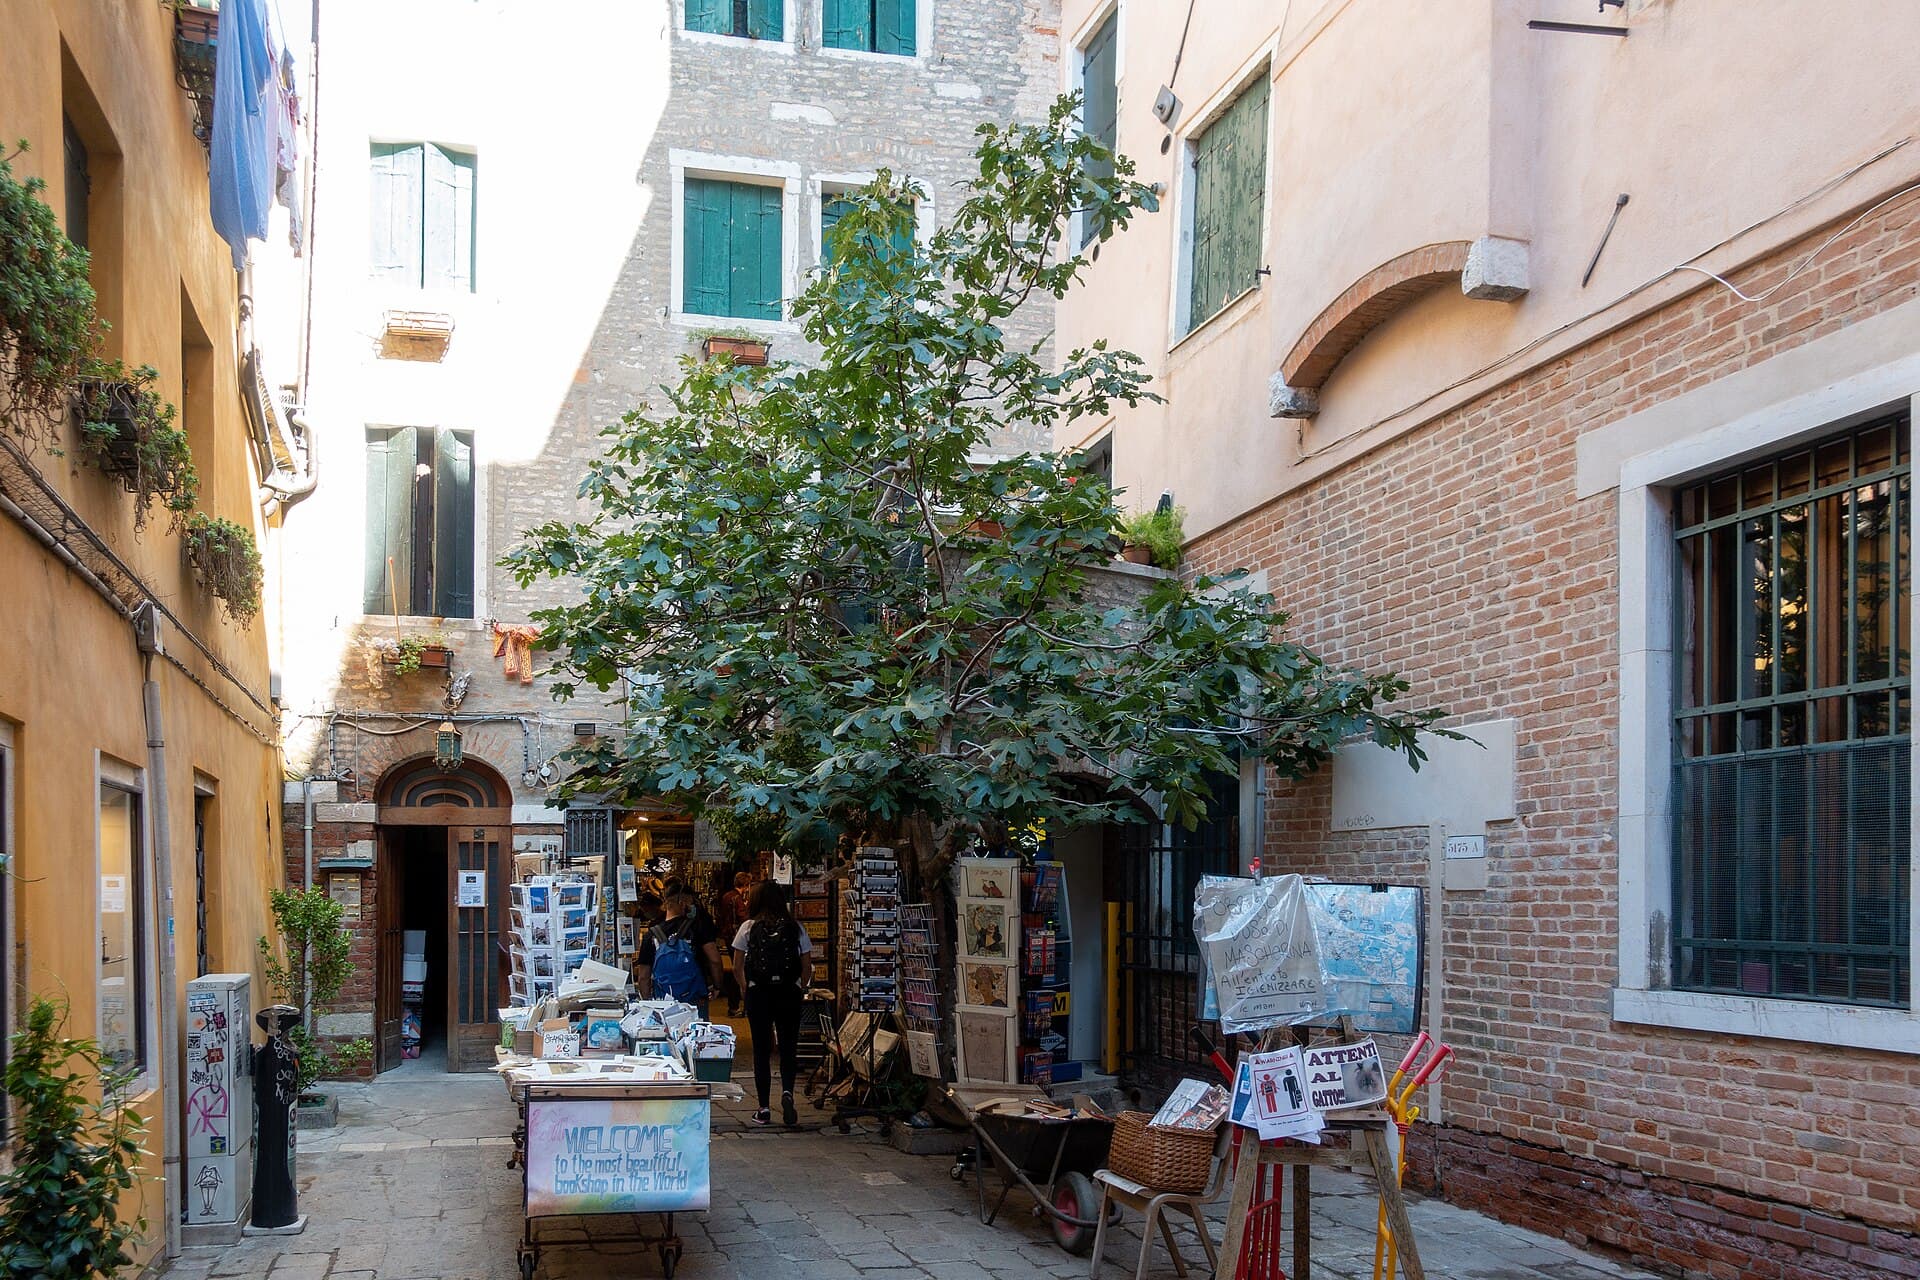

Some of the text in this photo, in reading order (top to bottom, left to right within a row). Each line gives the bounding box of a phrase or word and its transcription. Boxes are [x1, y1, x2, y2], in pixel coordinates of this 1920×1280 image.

[1448, 842, 1468, 853] 5175
[1308, 1042, 1377, 1066] ATTENTI
[1310, 1072, 1341, 1084] AL
[565, 1125, 672, 1154] WELCOME
[555, 1152, 683, 1174] to the most beautiful
[613, 1174, 624, 1193] in
[629, 1171, 649, 1192] the
